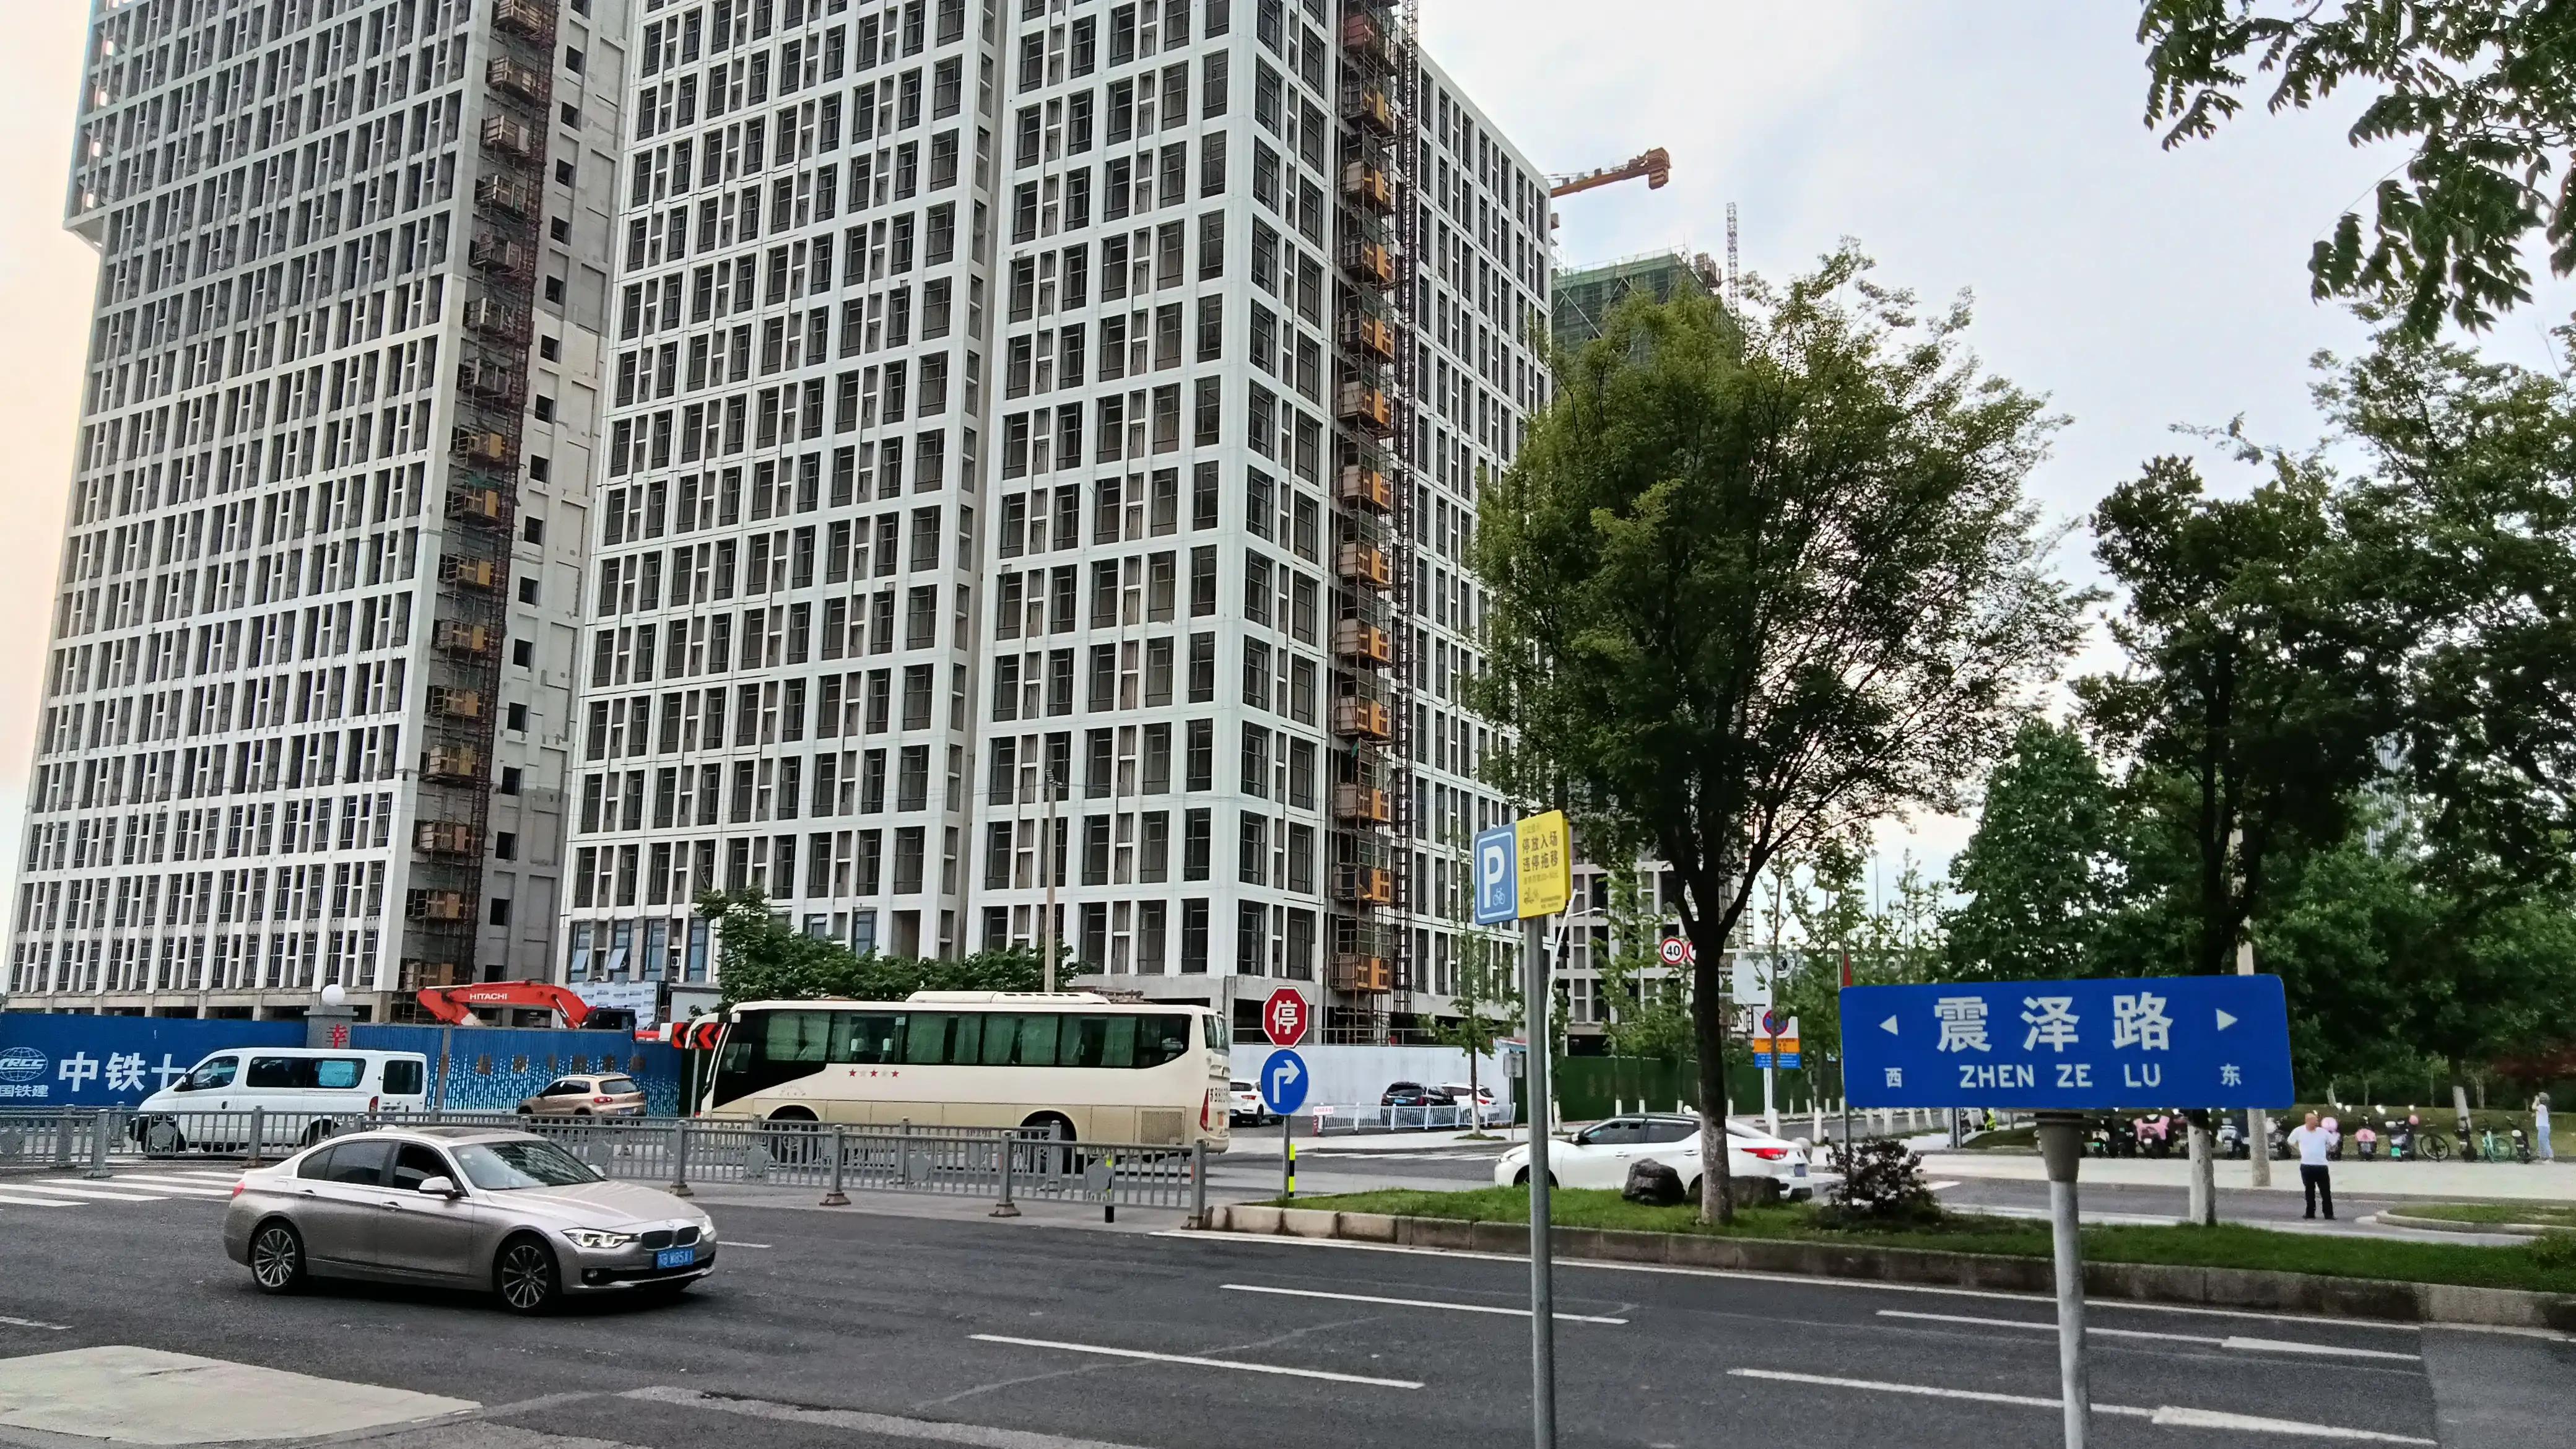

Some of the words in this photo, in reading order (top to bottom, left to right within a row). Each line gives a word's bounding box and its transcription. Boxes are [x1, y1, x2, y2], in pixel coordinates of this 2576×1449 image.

[1523, 831, 1558, 854] 停放入场
[1484, 846, 1505, 908] P
[1666, 945, 1680, 956] 40
[1273, 999, 1298, 1034] 停
[1934, 991, 2174, 1053] 震泽路
[1884, 1068, 1902, 1089] 西
[1959, 1064, 2035, 1088] ZHEN
[2056, 1064, 2093, 1088] ZE
[2124, 1063, 2161, 1088] LU
[2219, 1063, 2242, 1087] 东
